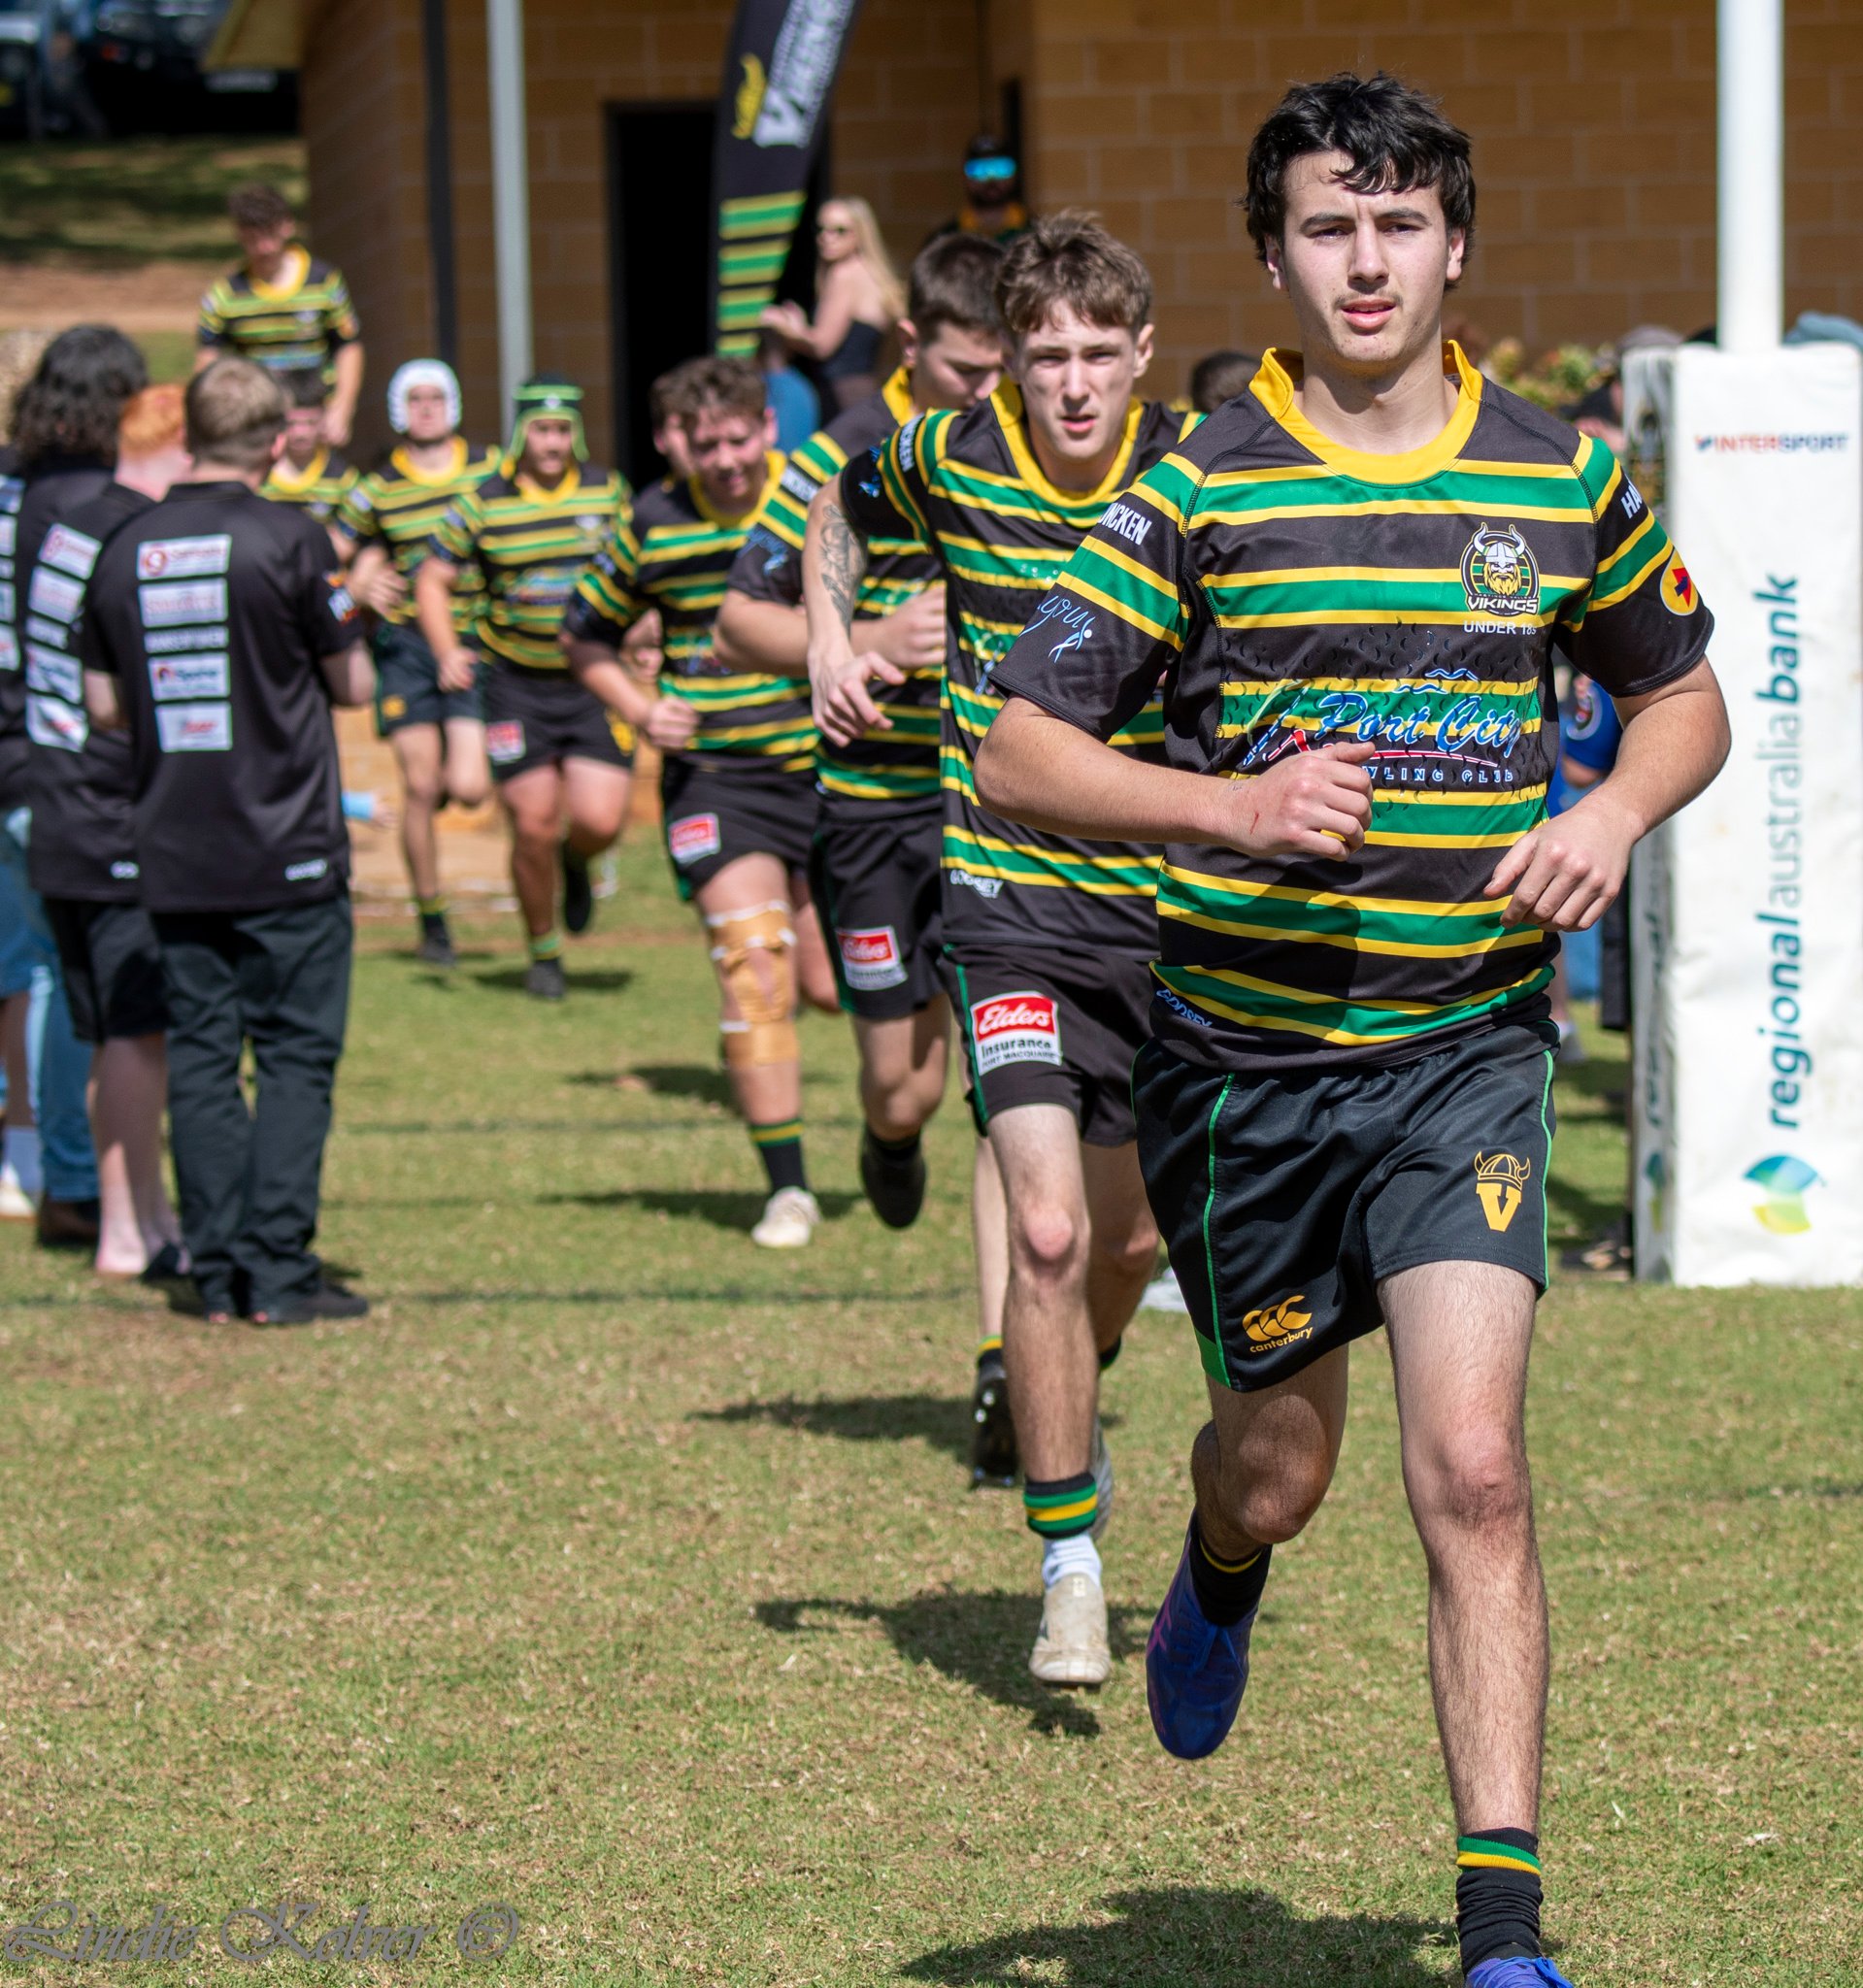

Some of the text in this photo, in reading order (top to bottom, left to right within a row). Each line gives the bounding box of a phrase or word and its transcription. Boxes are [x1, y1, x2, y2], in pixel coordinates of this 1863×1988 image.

[1714, 433, 1849, 453] INTERSPORT
[1467, 596, 1539, 613] VIKINGS
[1463, 620, 1517, 635] UNDER
[1314, 692, 1431, 746] Port
[1437, 695, 1522, 758] City
[1361, 766, 1445, 782] WLING
[979, 1003, 1051, 1035] Elders
[981, 1037, 1052, 1058] Insurance
[1249, 1327, 1314, 1353] canterbury
